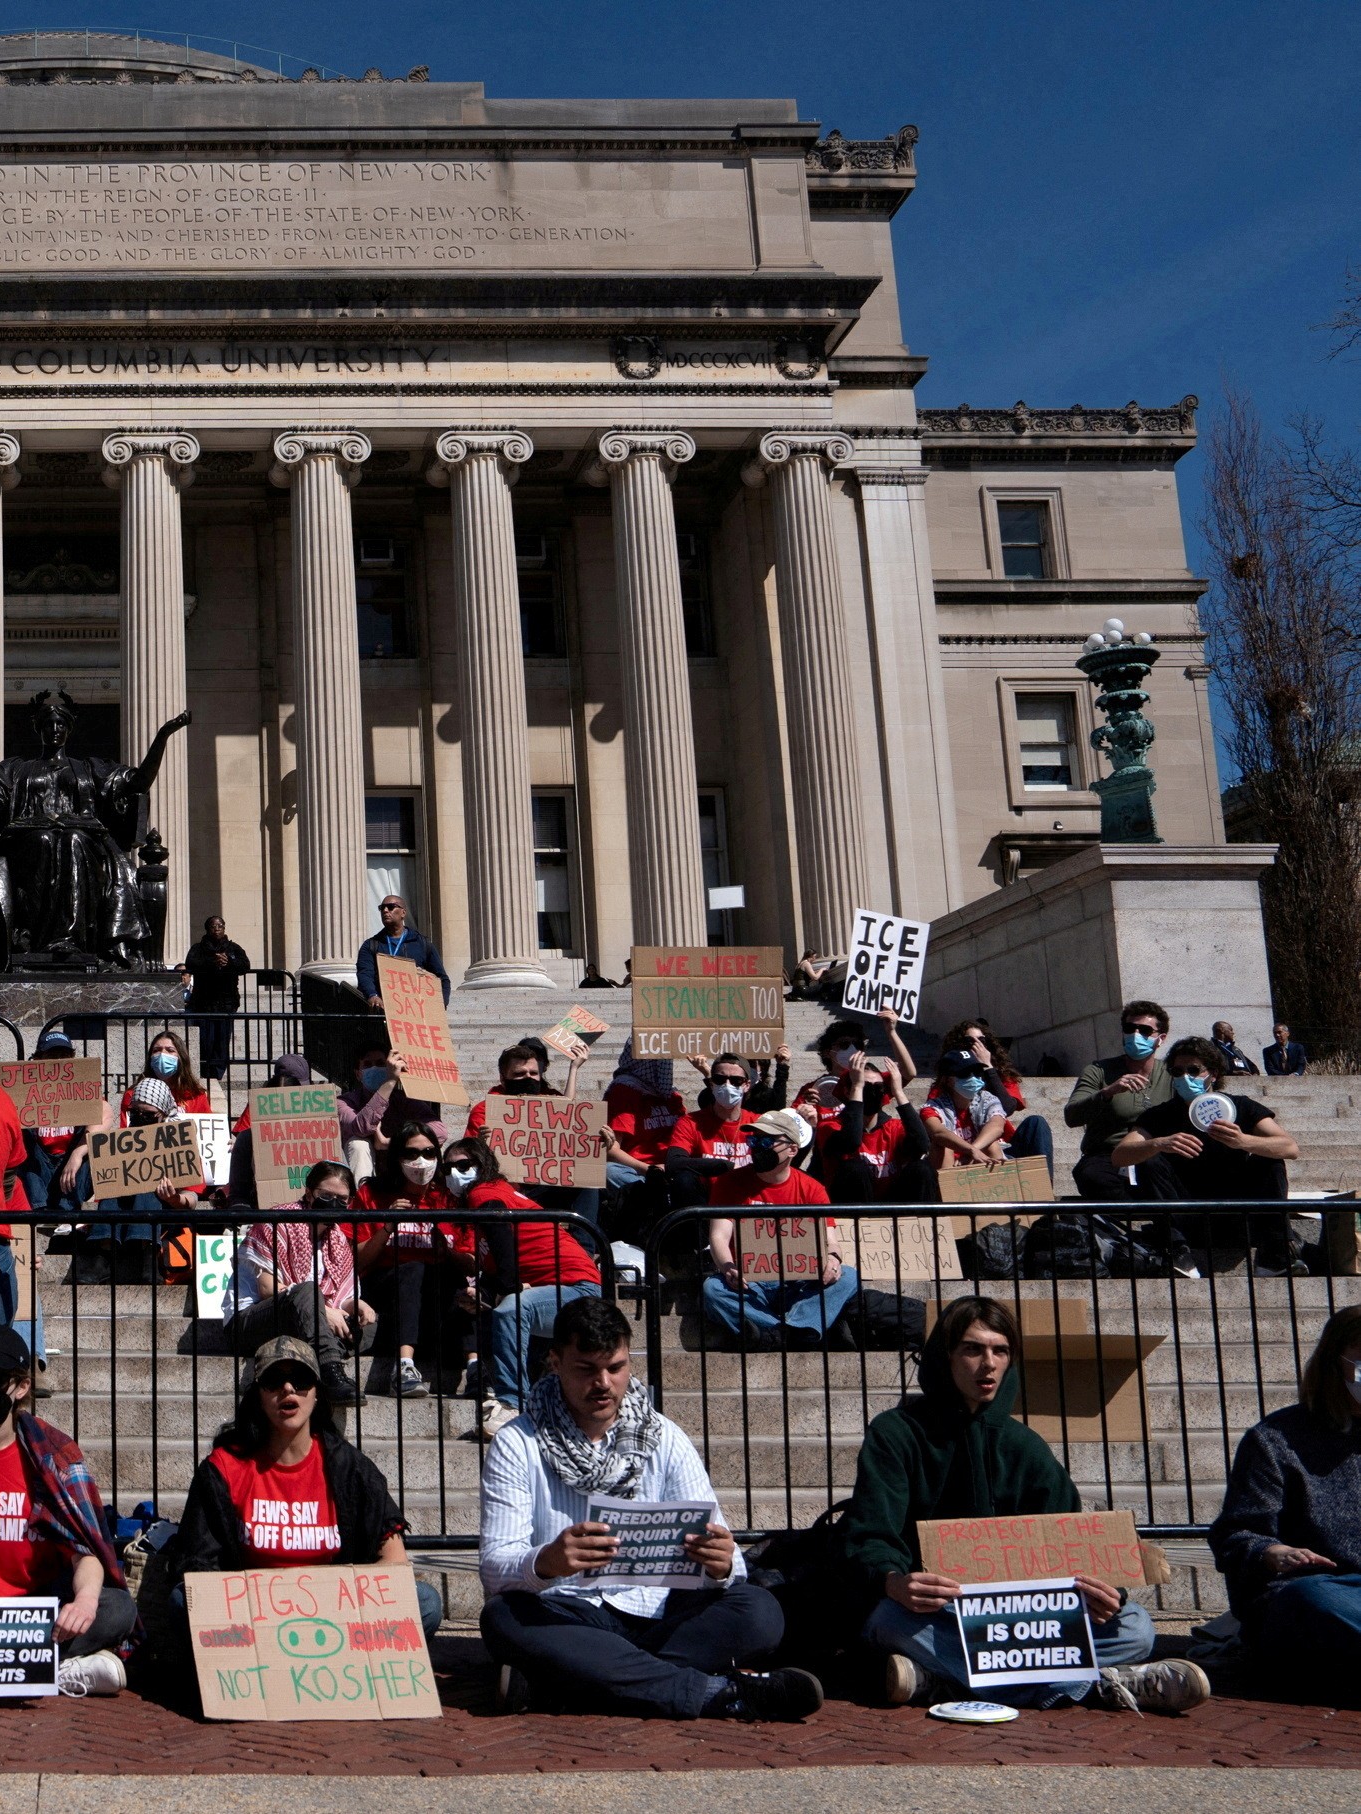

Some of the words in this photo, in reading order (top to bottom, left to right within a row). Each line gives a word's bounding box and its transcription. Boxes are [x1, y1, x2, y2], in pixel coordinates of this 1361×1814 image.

[23, 165, 50, 185] IN
[65, 164, 121, 185] THE
[137, 164, 273, 184] PROVINCE
[287, 163, 322, 182] OF
[338, 162, 399, 182] NEW
[414, 162, 489, 183] YORK
[17, 190, 38, 204] IN
[53, 190, 90, 203] THE
[104, 189, 162, 203] REIGN
[176, 189, 203, 203] OF
[213, 187, 293, 202] GEORGE
[304, 187, 319, 202] II
[46, 210, 68, 224] BY
[88, 209, 122, 223] THE
[132, 209, 203, 222] PEOPLE
[214, 208, 242, 223] OF
[255, 208, 293, 222] THE
[303, 207, 361, 222] STATE
[373, 207, 400, 222] OF
[410, 207, 456, 222] NEW
[468, 207, 527, 222] YORK
[112, 230, 153, 243] AND
[165, 228, 270, 243] CHERISHED
[282, 228, 333, 242] FROM
[344, 227, 465, 242] GENERATION
[473, 227, 497, 242] TO
[509, 227, 627, 242] GENERATION
[10, 349, 202, 375] COLUMBIA
[221, 349, 439, 375] UNIVERSITY
[857, 916, 919, 958] ICE
[655, 955, 689, 976] WE
[701, 955, 759, 976] WERE
[855, 950, 913, 985] OFF
[385, 968, 436, 997] JEWS
[392, 994, 427, 1019] SAY
[641, 986, 748, 1020] STRANGERS
[750, 986, 781, 1020] TOO.
[845, 975, 917, 1020] CAMPUS
[390, 1019, 447, 1052] FREE
[639, 1032, 670, 1055] ICE
[677, 1032, 703, 1055] OFF
[708, 1031, 772, 1056] CAMPUS
[2, 1062, 75, 1088] JEWS
[25, 1081, 102, 1106] AGAINST
[256, 1089, 336, 1117] RELEASE
[1197, 1099, 1220, 1110] JEWS
[18, 1105, 61, 1128] CE!
[503, 1099, 594, 1134] JEWS
[1201, 1109, 1223, 1125] ICE
[92, 1127, 148, 1159] PIGS
[153, 1121, 193, 1150] ARE
[259, 1119, 339, 1143] MAHMOUD
[489, 1128, 604, 1159] AGAINST
[271, 1140, 340, 1167] KHALIL
[96, 1166, 120, 1182] NOT
[122, 1149, 202, 1187] KOSHER
[521, 1157, 576, 1187] ICE
[251, 1498, 290, 1526] JEWS
[291, 1500, 320, 1526] SAY
[937, 1517, 1038, 1546] PROTECT
[1056, 1515, 1106, 1538] THE
[971, 1541, 1149, 1582] STUDENTS
[222, 1573, 319, 1623] PIGS
[338, 1574, 398, 1611] ARE
[962, 1592, 1080, 1617] MAHMOUD
[986, 1623, 1009, 1642] IS
[1013, 1619, 1062, 1641] OUR
[18, 1649, 53, 1663] OUR
[977, 1646, 1082, 1670] BROTHER
[216, 1665, 271, 1701] NOT
[289, 1659, 431, 1705] KOSHER
